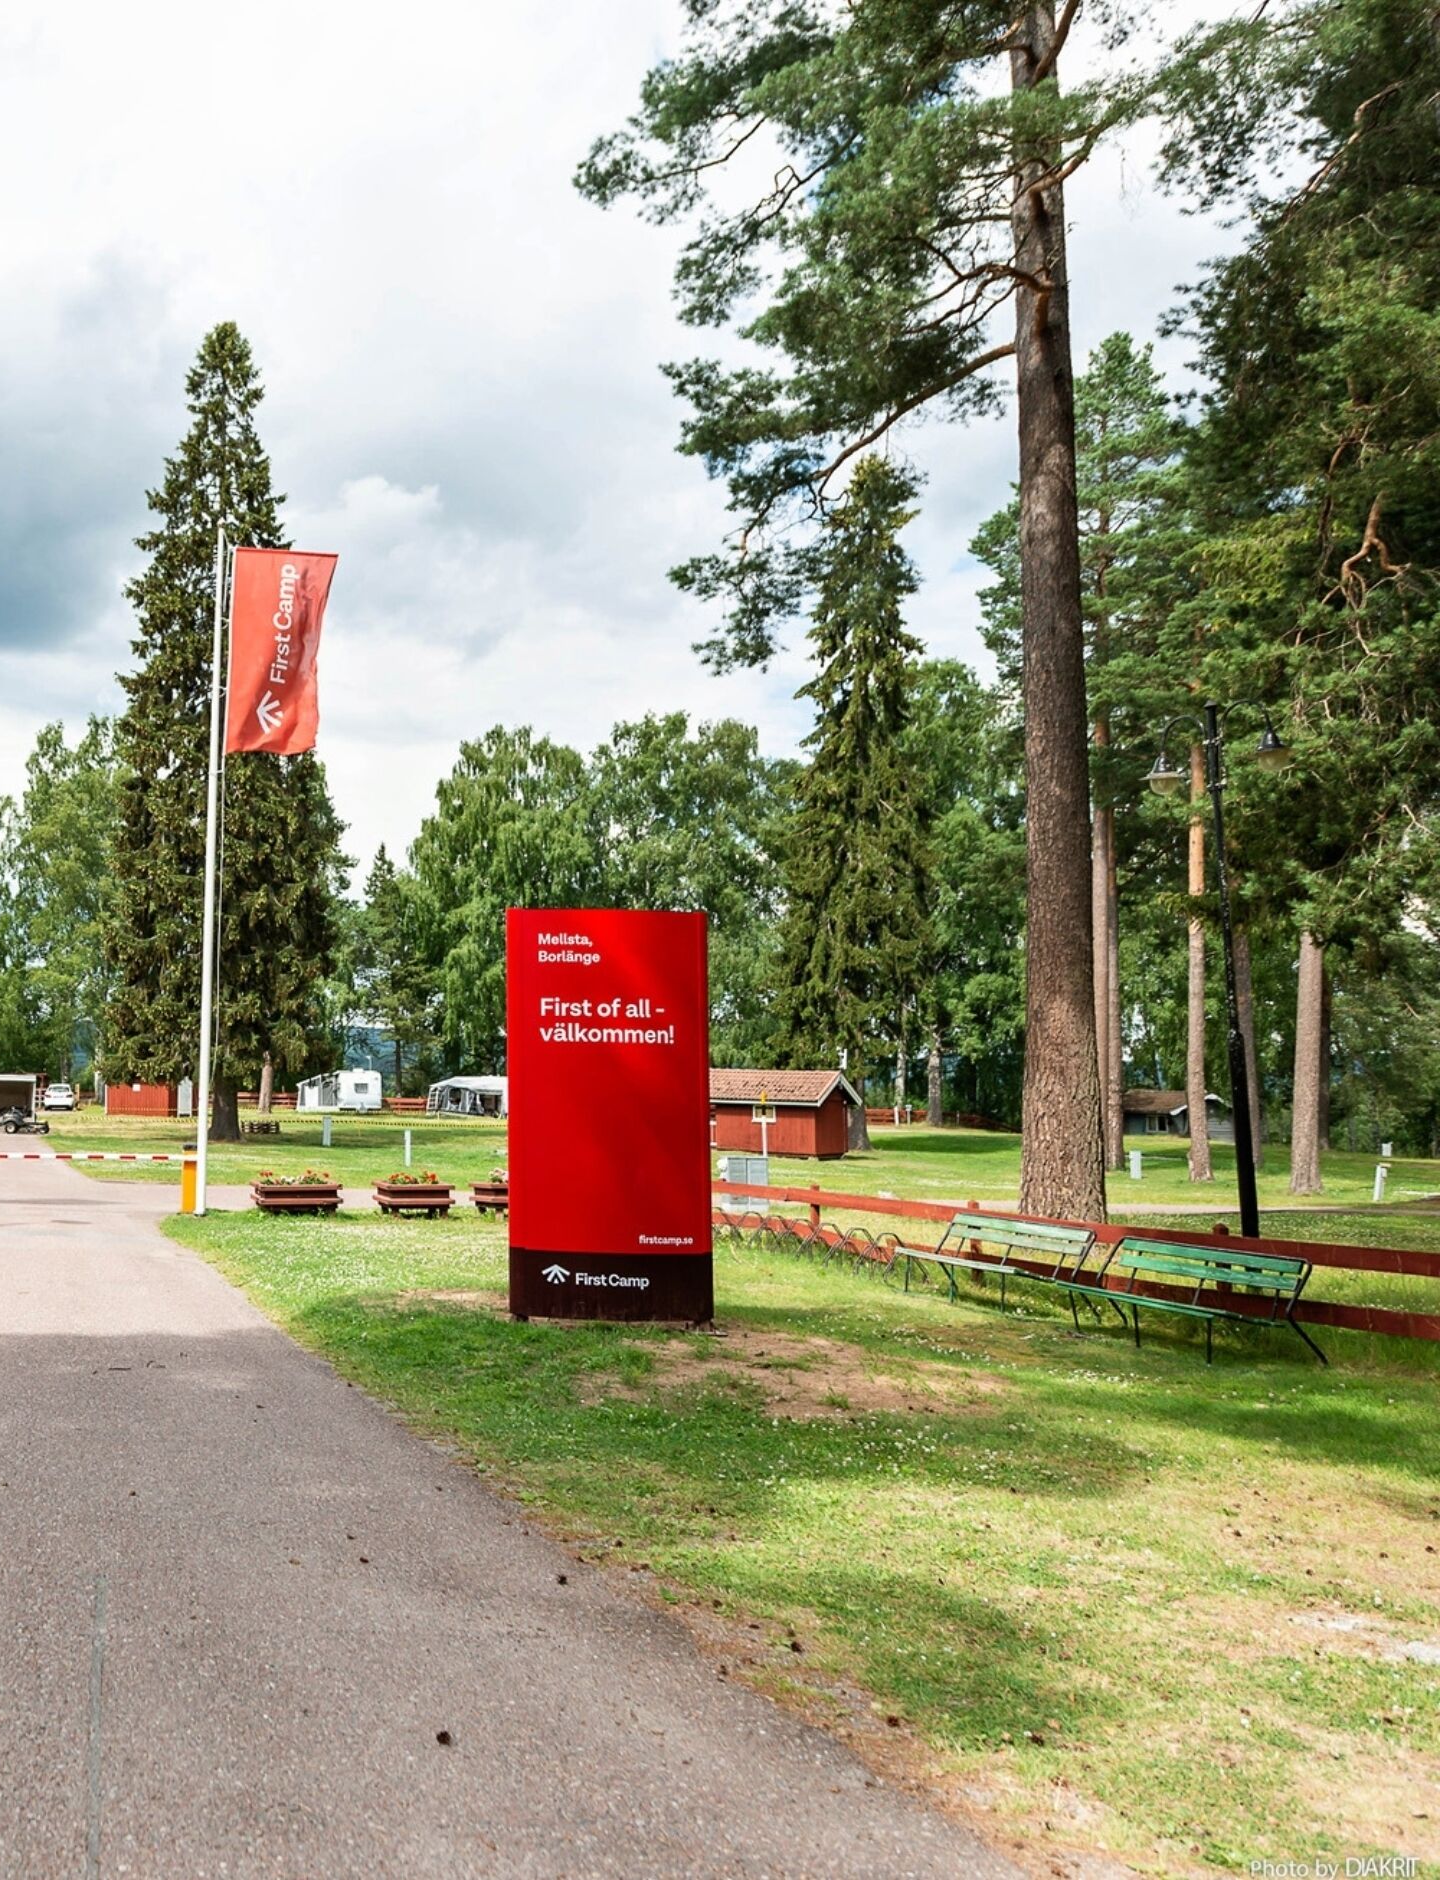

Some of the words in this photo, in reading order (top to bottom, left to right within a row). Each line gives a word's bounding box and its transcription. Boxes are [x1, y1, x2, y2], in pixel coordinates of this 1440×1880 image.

[272, 563, 300, 630] Camp
[270, 632, 291, 684] First
[538, 932, 593, 947] Mellsta,
[538, 950, 601, 965] Borlänge
[540, 997, 592, 1017] First
[597, 998, 621, 1018] of
[625, 998, 651, 1018] all
[540, 1022, 674, 1044] välkommen!
[639, 1234, 693, 1246] firstcamp.se
[575, 1272, 607, 1287] First
[608, 1273, 650, 1290] Camp
